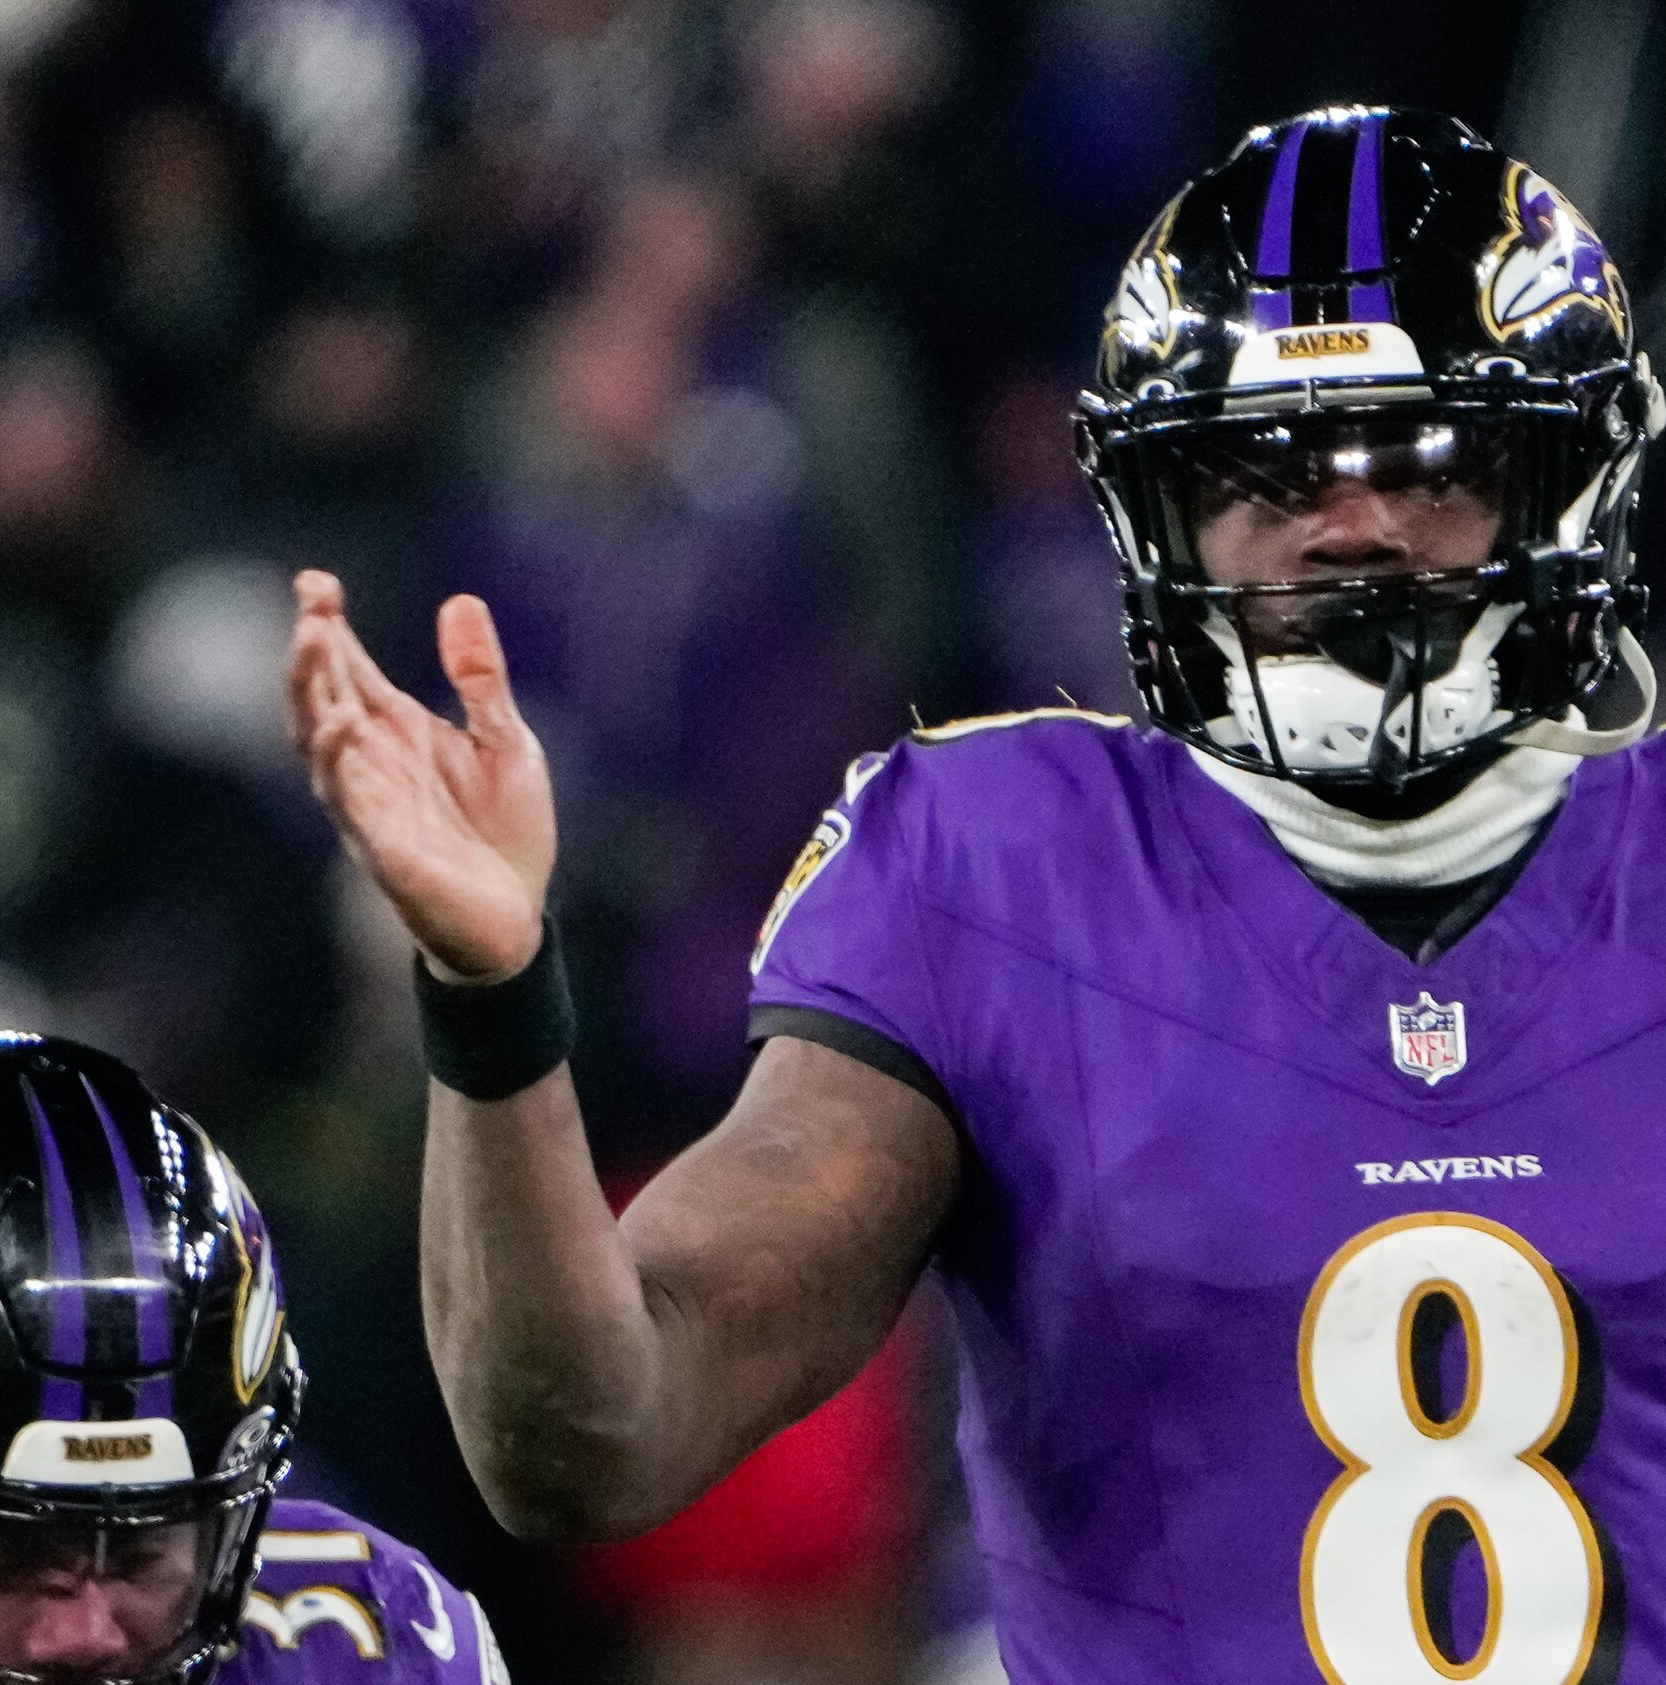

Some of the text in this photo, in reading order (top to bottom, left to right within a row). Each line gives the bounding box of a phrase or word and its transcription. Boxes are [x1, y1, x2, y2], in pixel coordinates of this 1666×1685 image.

[1275, 329, 1369, 359] RAVENS
[1406, 1033, 1455, 1067] NFL
[1355, 1154, 1544, 1185] RAVENS
[61, 1433, 152, 1463] RAVENS
